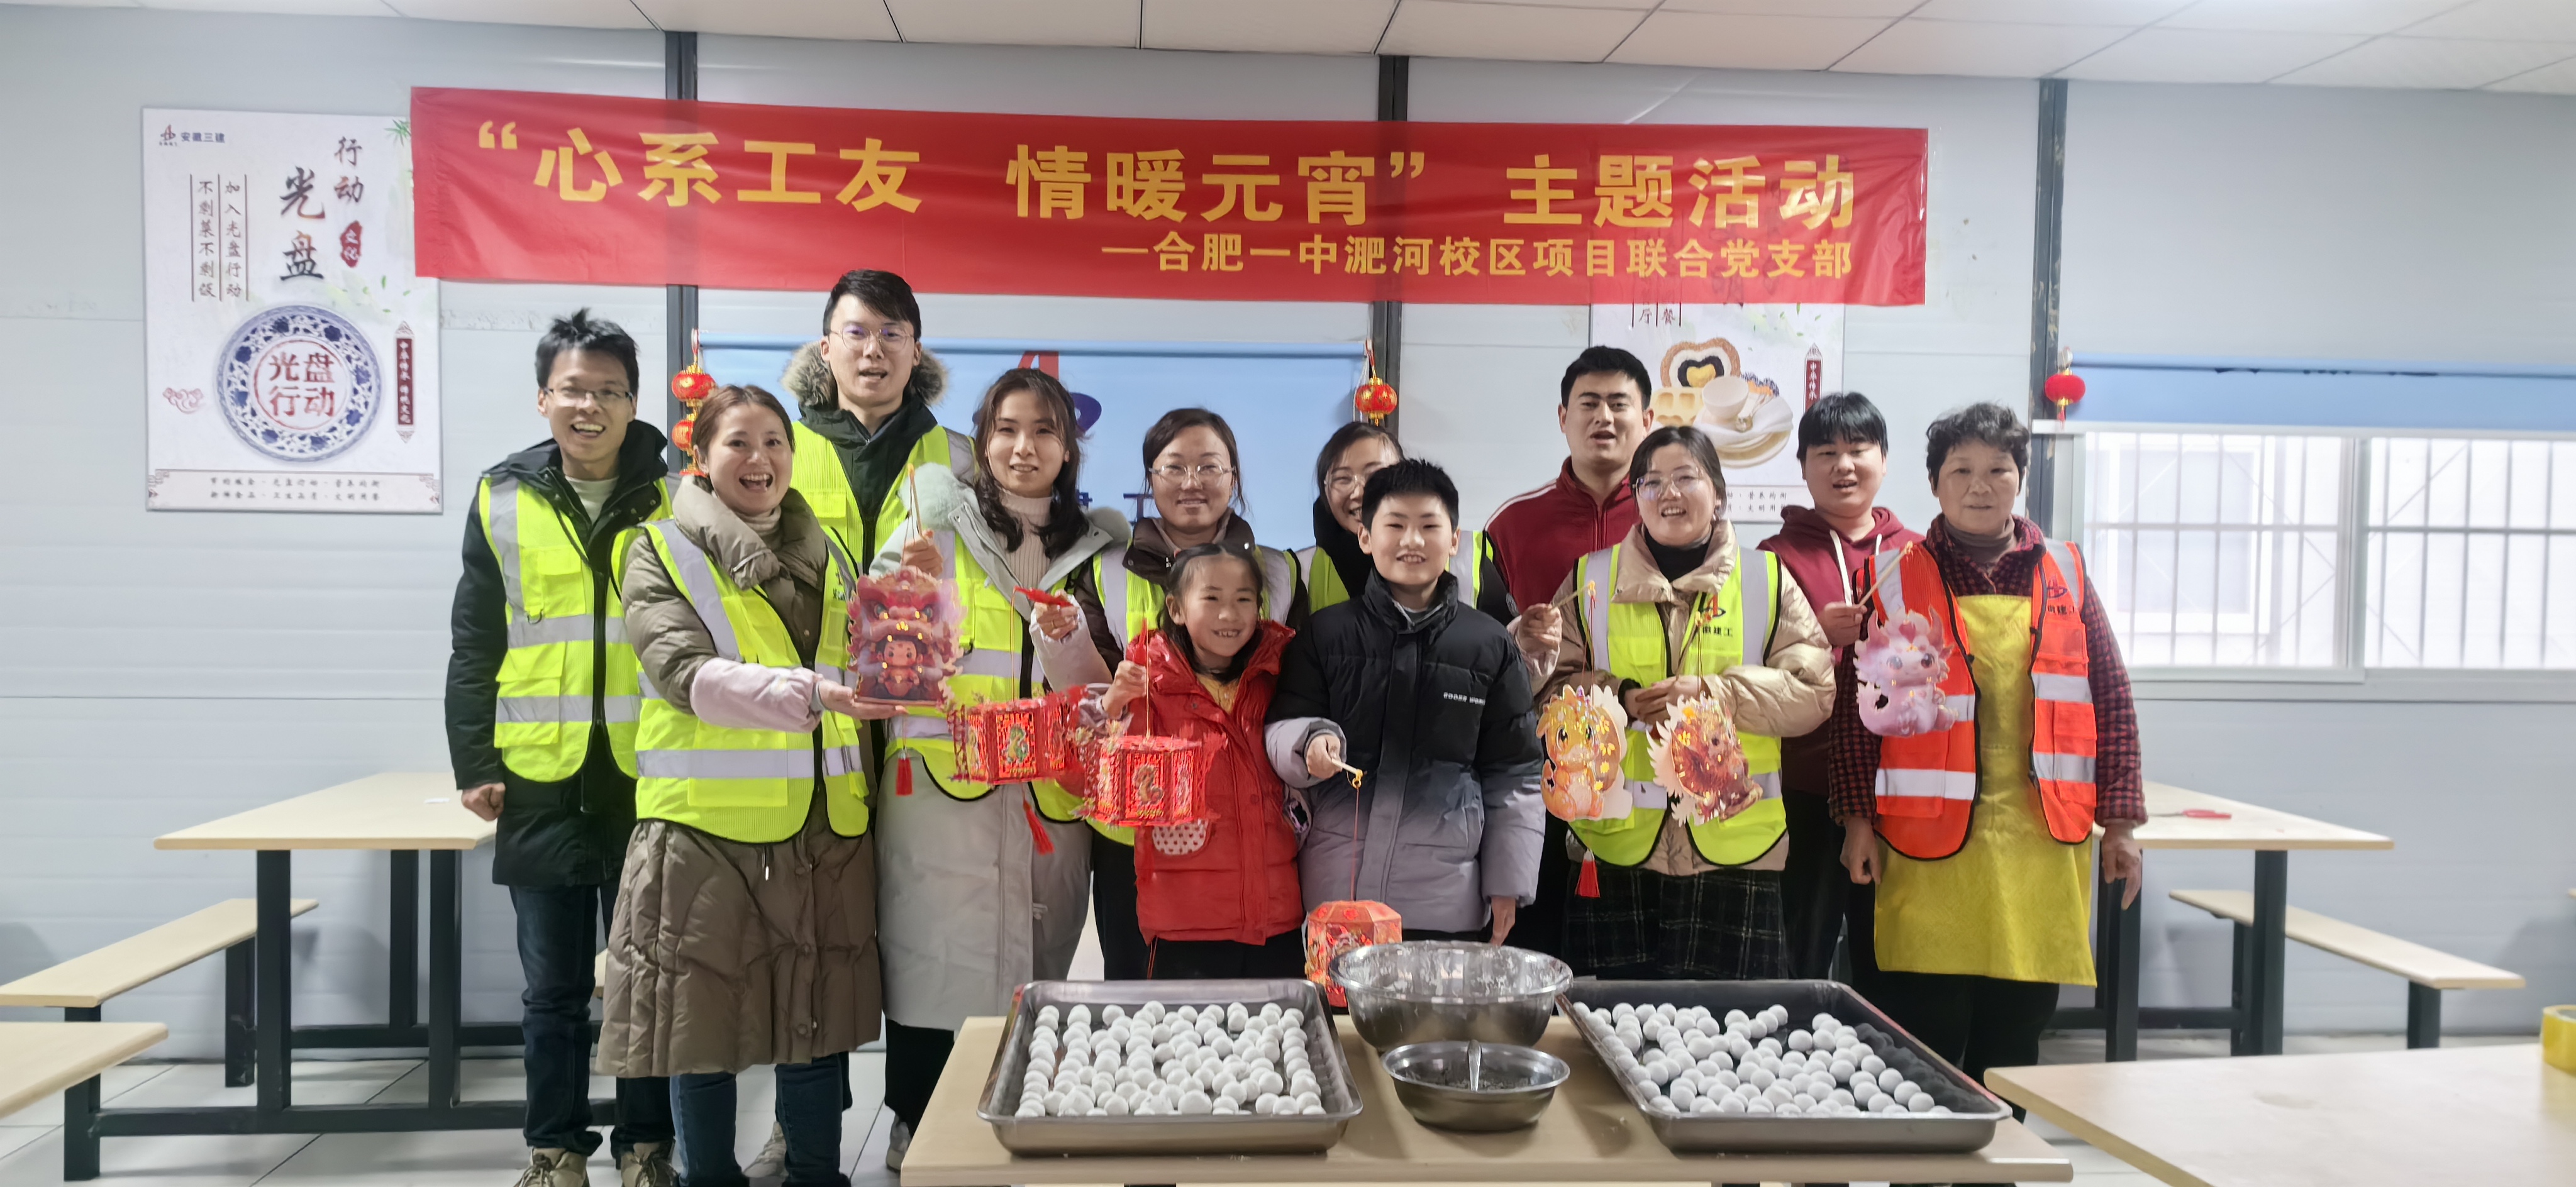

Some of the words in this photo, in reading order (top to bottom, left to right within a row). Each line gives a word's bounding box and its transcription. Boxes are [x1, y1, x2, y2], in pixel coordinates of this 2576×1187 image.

[279, 165, 326, 281] 光盘
[334, 136, 364, 203] 行动
[479, 120, 923, 213] “心系工友
[1006, 143, 1425, 226] 情暖元宵”
[1504, 153, 1854, 230] 主题活动
[197, 180, 216, 298] 不剩菜不剩饭
[224, 180, 243, 298] 加入光盘行动
[269, 351, 335, 383] 光盘
[269, 385, 335, 417] 行动
